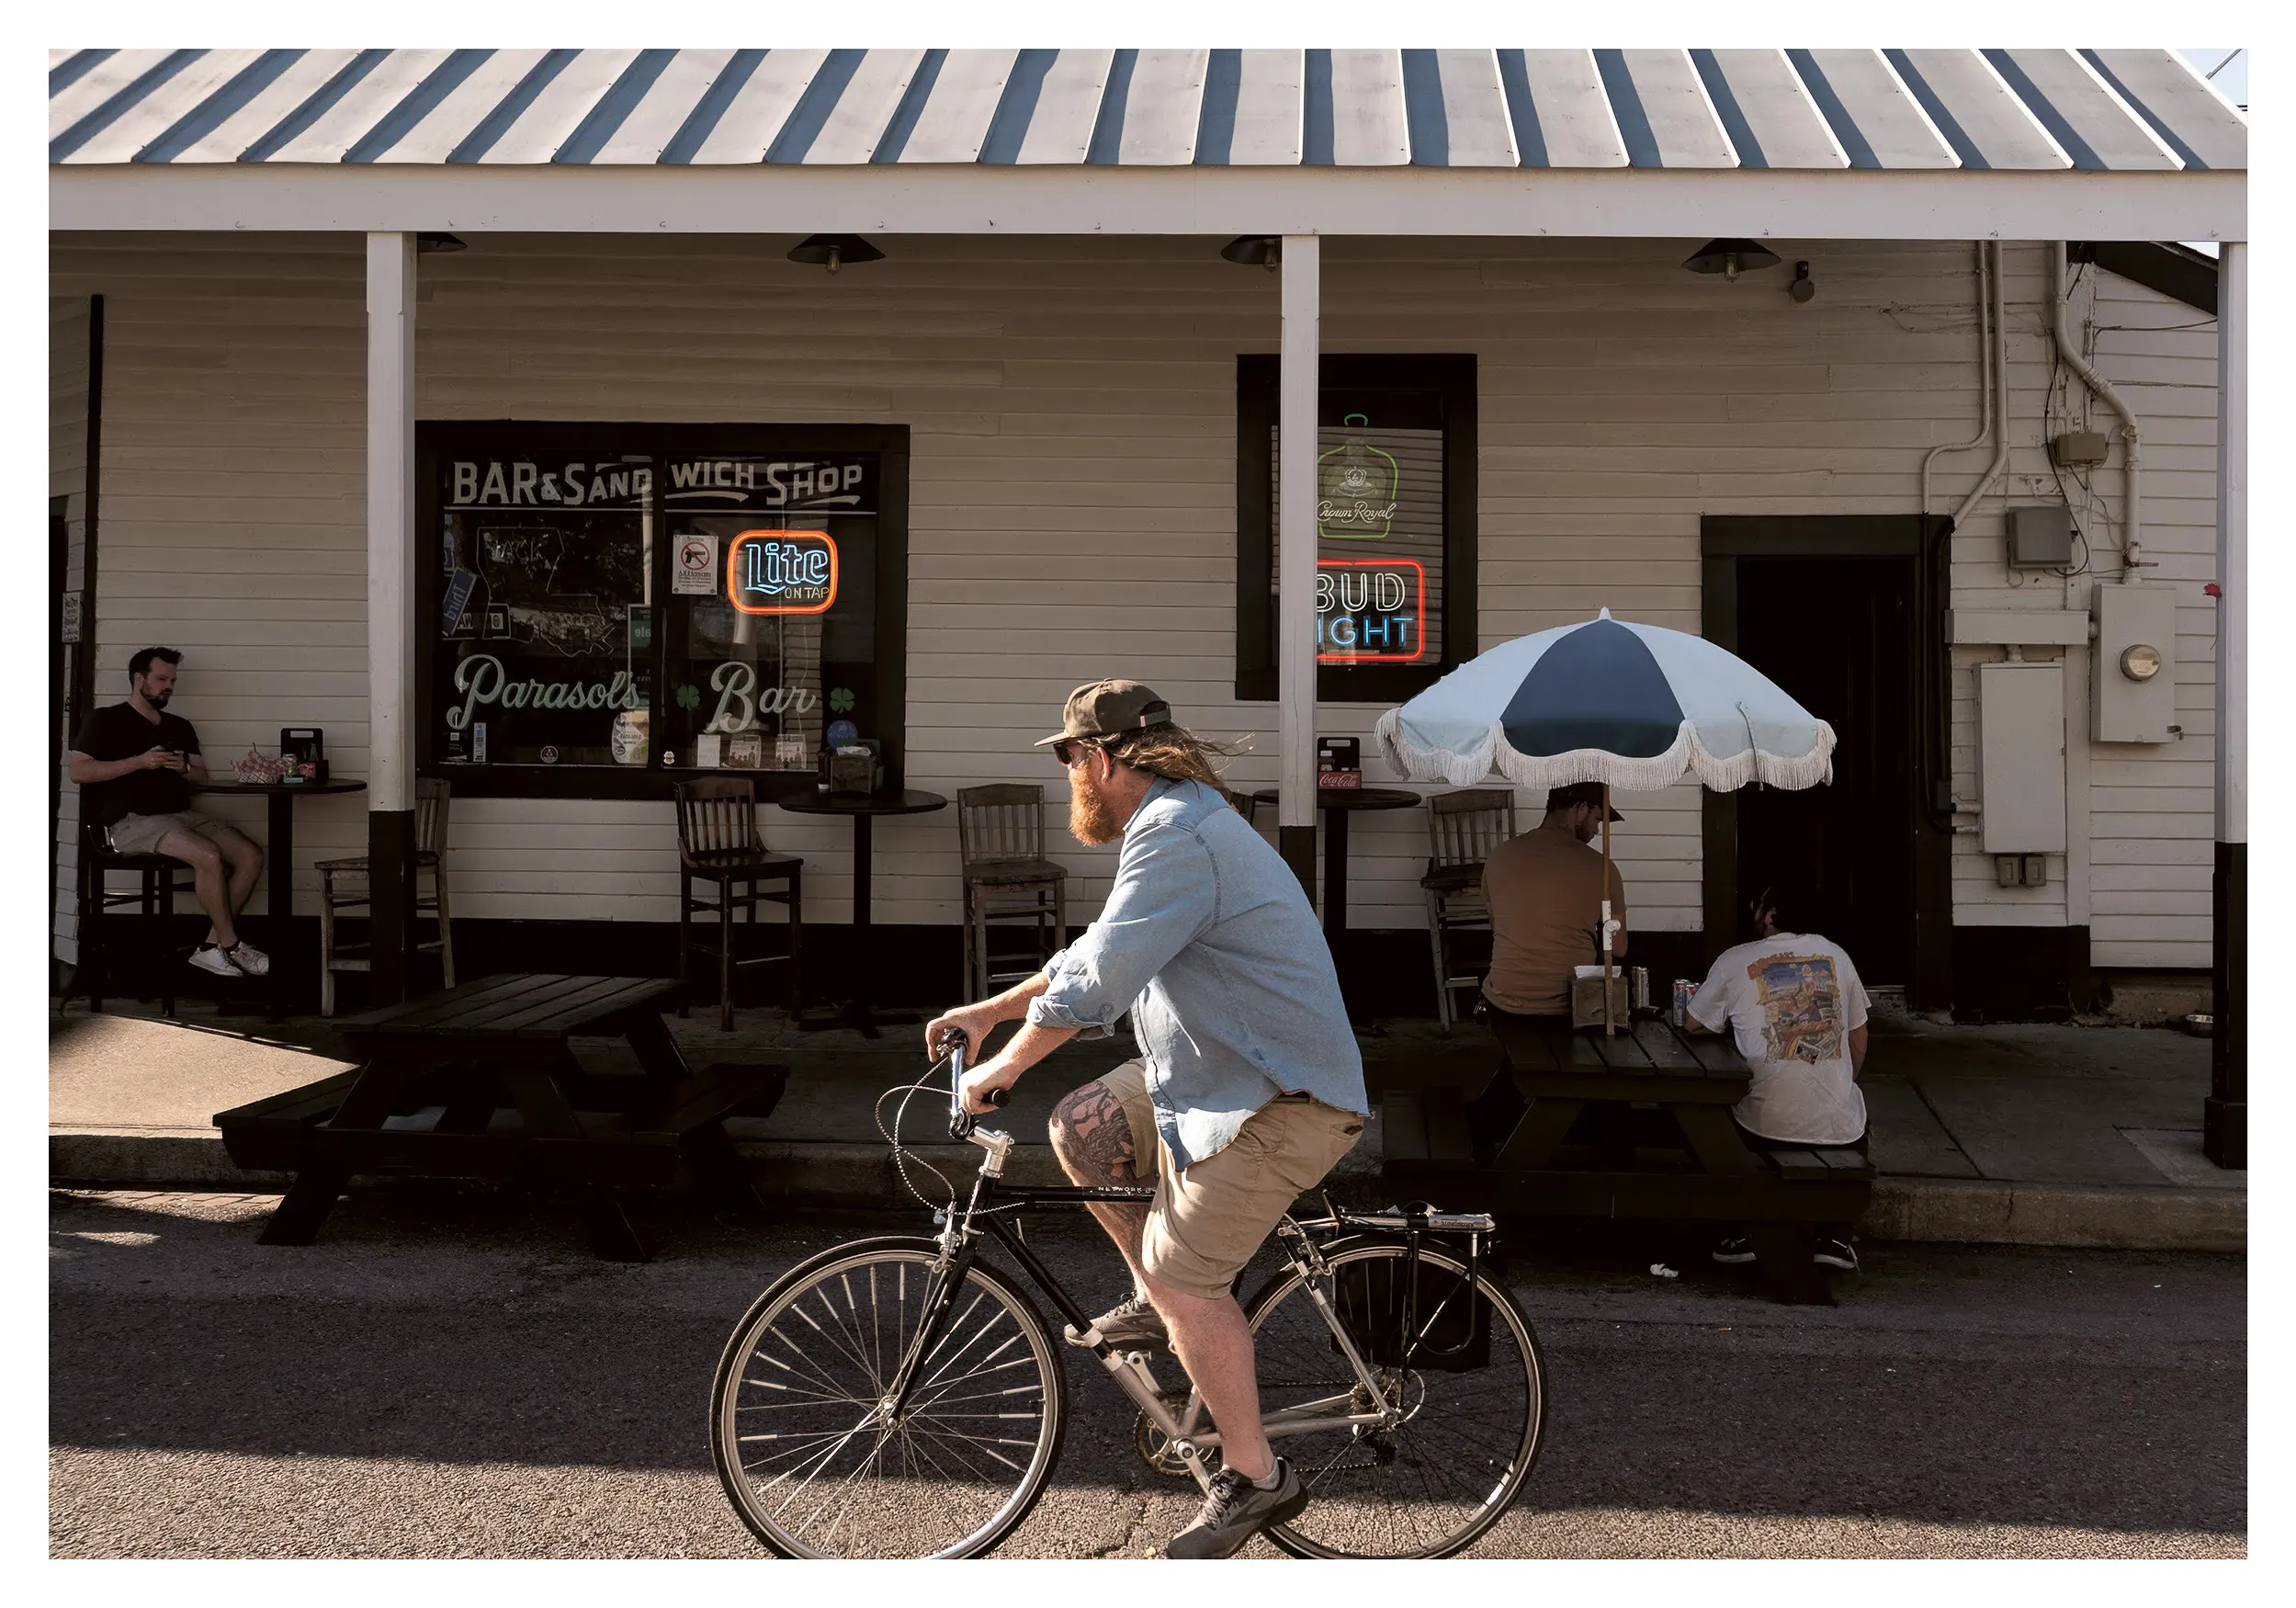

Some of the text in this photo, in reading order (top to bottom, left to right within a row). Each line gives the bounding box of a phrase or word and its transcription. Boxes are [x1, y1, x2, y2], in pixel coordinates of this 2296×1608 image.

[766, 462, 863, 505] SHOP
[1341, 501, 1397, 524] Royal
[745, 542, 829, 595] Lite
[784, 587, 830, 599] ON TAP
[1317, 572, 1406, 613] BUD
[1318, 616, 1414, 647] IGHT
[446, 653, 816, 734] Parasol's Bar
[1319, 773, 1360, 787] Coca-Cola
